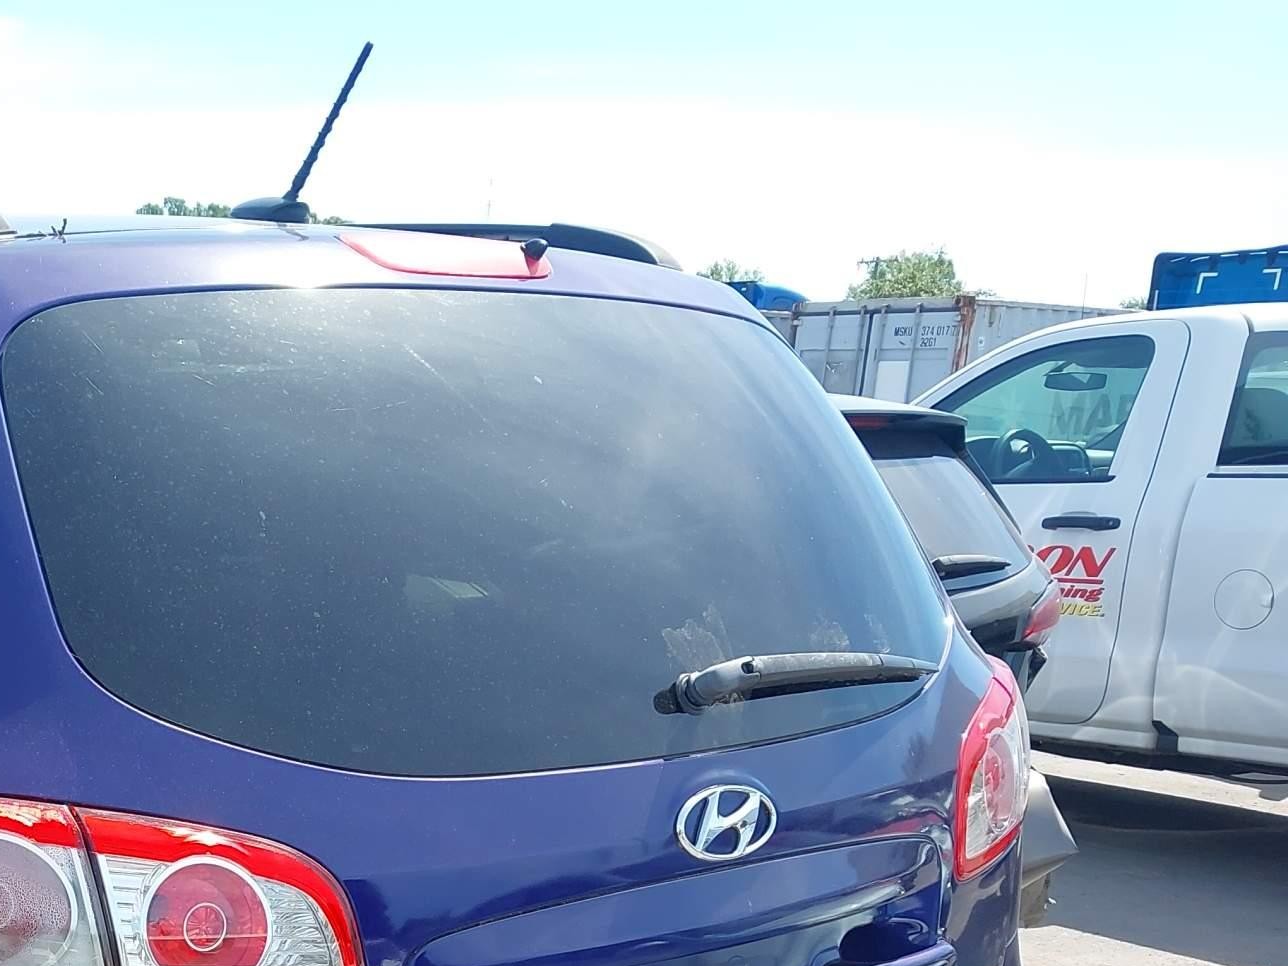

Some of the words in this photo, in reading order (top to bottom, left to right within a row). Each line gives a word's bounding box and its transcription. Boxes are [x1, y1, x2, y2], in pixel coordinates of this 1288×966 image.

[894, 327, 913, 336] MSKU
[921, 326, 935, 336] 374
[936, 326, 950, 336] 017
[1028, 545, 1116, 577] ON
